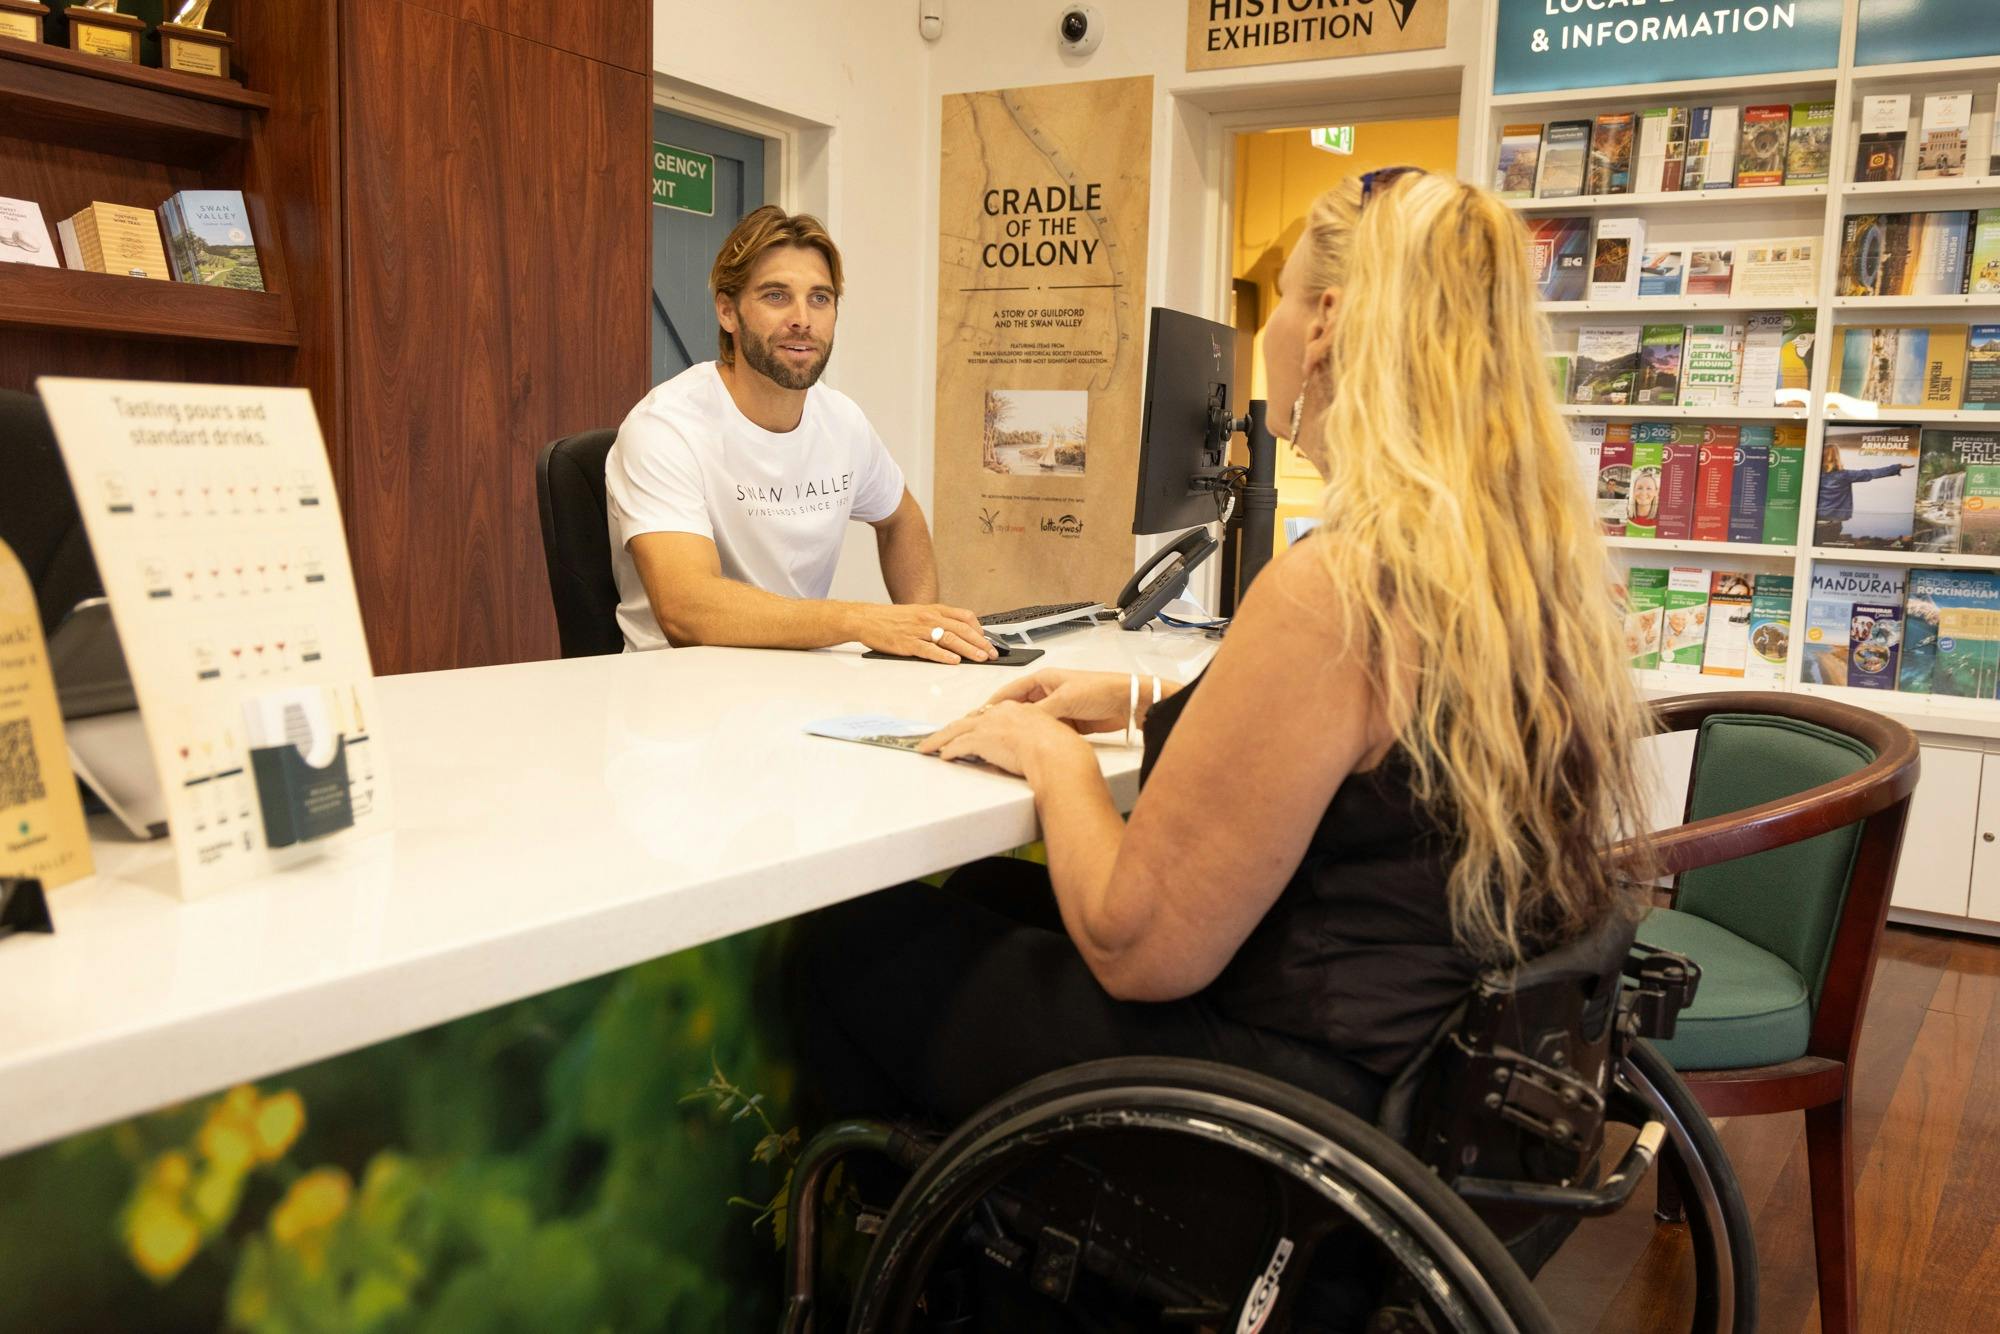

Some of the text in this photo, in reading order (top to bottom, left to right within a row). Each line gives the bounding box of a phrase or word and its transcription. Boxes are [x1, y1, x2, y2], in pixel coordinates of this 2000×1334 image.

[1207, 11, 1374, 51] EXHIBITION
[1531, 28, 1550, 53] &
[1561, 3, 1796, 50] INFORMATION
[983, 183, 1102, 216] CRADLE
[196, 212, 236, 220] VALLEY
[1006, 217, 1077, 238] OF THE
[982, 238, 1100, 269] COLONY
[993, 308, 1085, 319] A STORY OF GUILDFORD
[994, 318, 1083, 329] AND THE SWAN VALLEY
[1760, 316, 1781, 325] 302
[1690, 351, 1733, 359] GETTING
[1690, 373, 1735, 383] PERTH
[112, 396, 267, 423] Tasting pours and
[129, 425, 209, 446] standard
[1590, 427, 1604, 437] 101
[1887, 435, 1910, 443] HILLS
[1860, 442, 1910, 450] ARMADALE
[1951, 440, 2000, 453] PERTH
[736, 484, 783, 503] SWAN
[800, 501, 830, 514] SINCE
[1040, 516, 1084, 536] lotterywest
[1811, 575, 1905, 594] MANDURAH
[1916, 576, 1992, 590] REDISCOVER
[1916, 585, 1999, 599] ROCKINGHAM
[1856, 606, 1893, 614] MANDURAH
